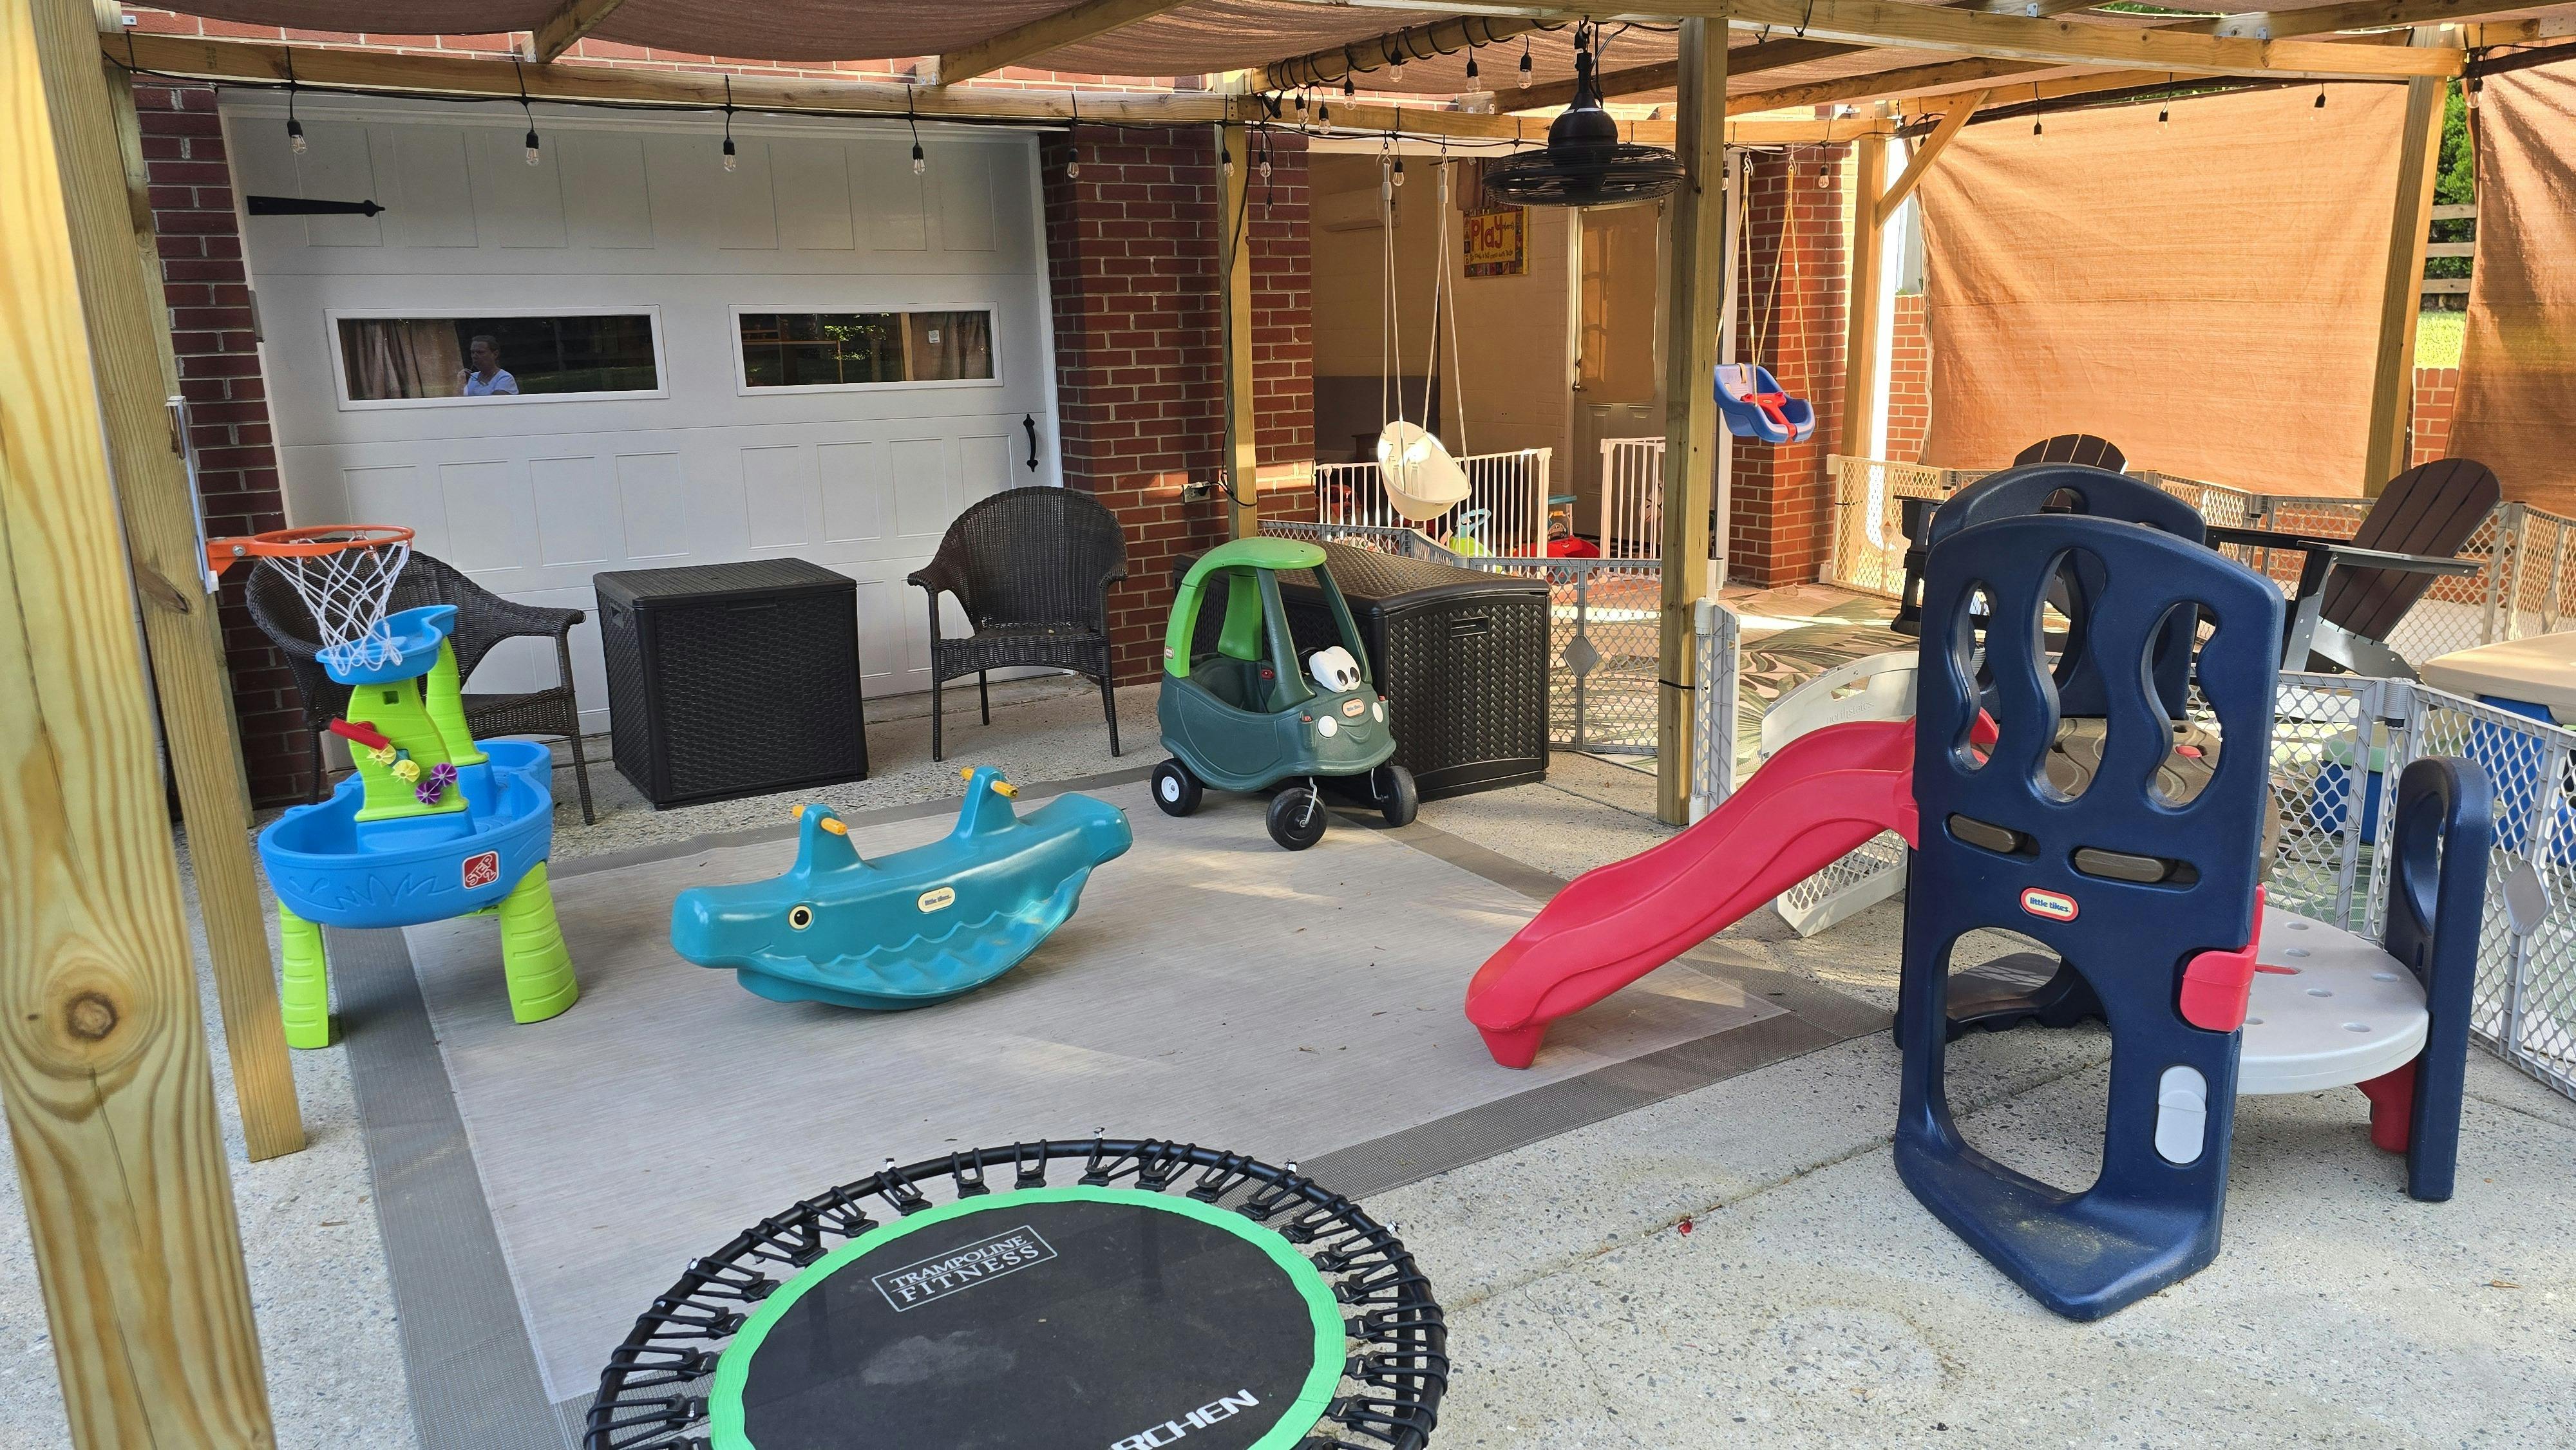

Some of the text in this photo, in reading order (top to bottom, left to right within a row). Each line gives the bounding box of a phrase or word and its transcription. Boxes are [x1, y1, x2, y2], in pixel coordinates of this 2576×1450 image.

[1471, 215, 1503, 252] Play
[466, 854, 493, 886] STEP
[484, 869, 497, 881] 2
[2029, 897, 2069, 912] little tikes
[889, 1235, 1027, 1288] TRAMPOLINE
[898, 1245, 1039, 1303] FITNESS
